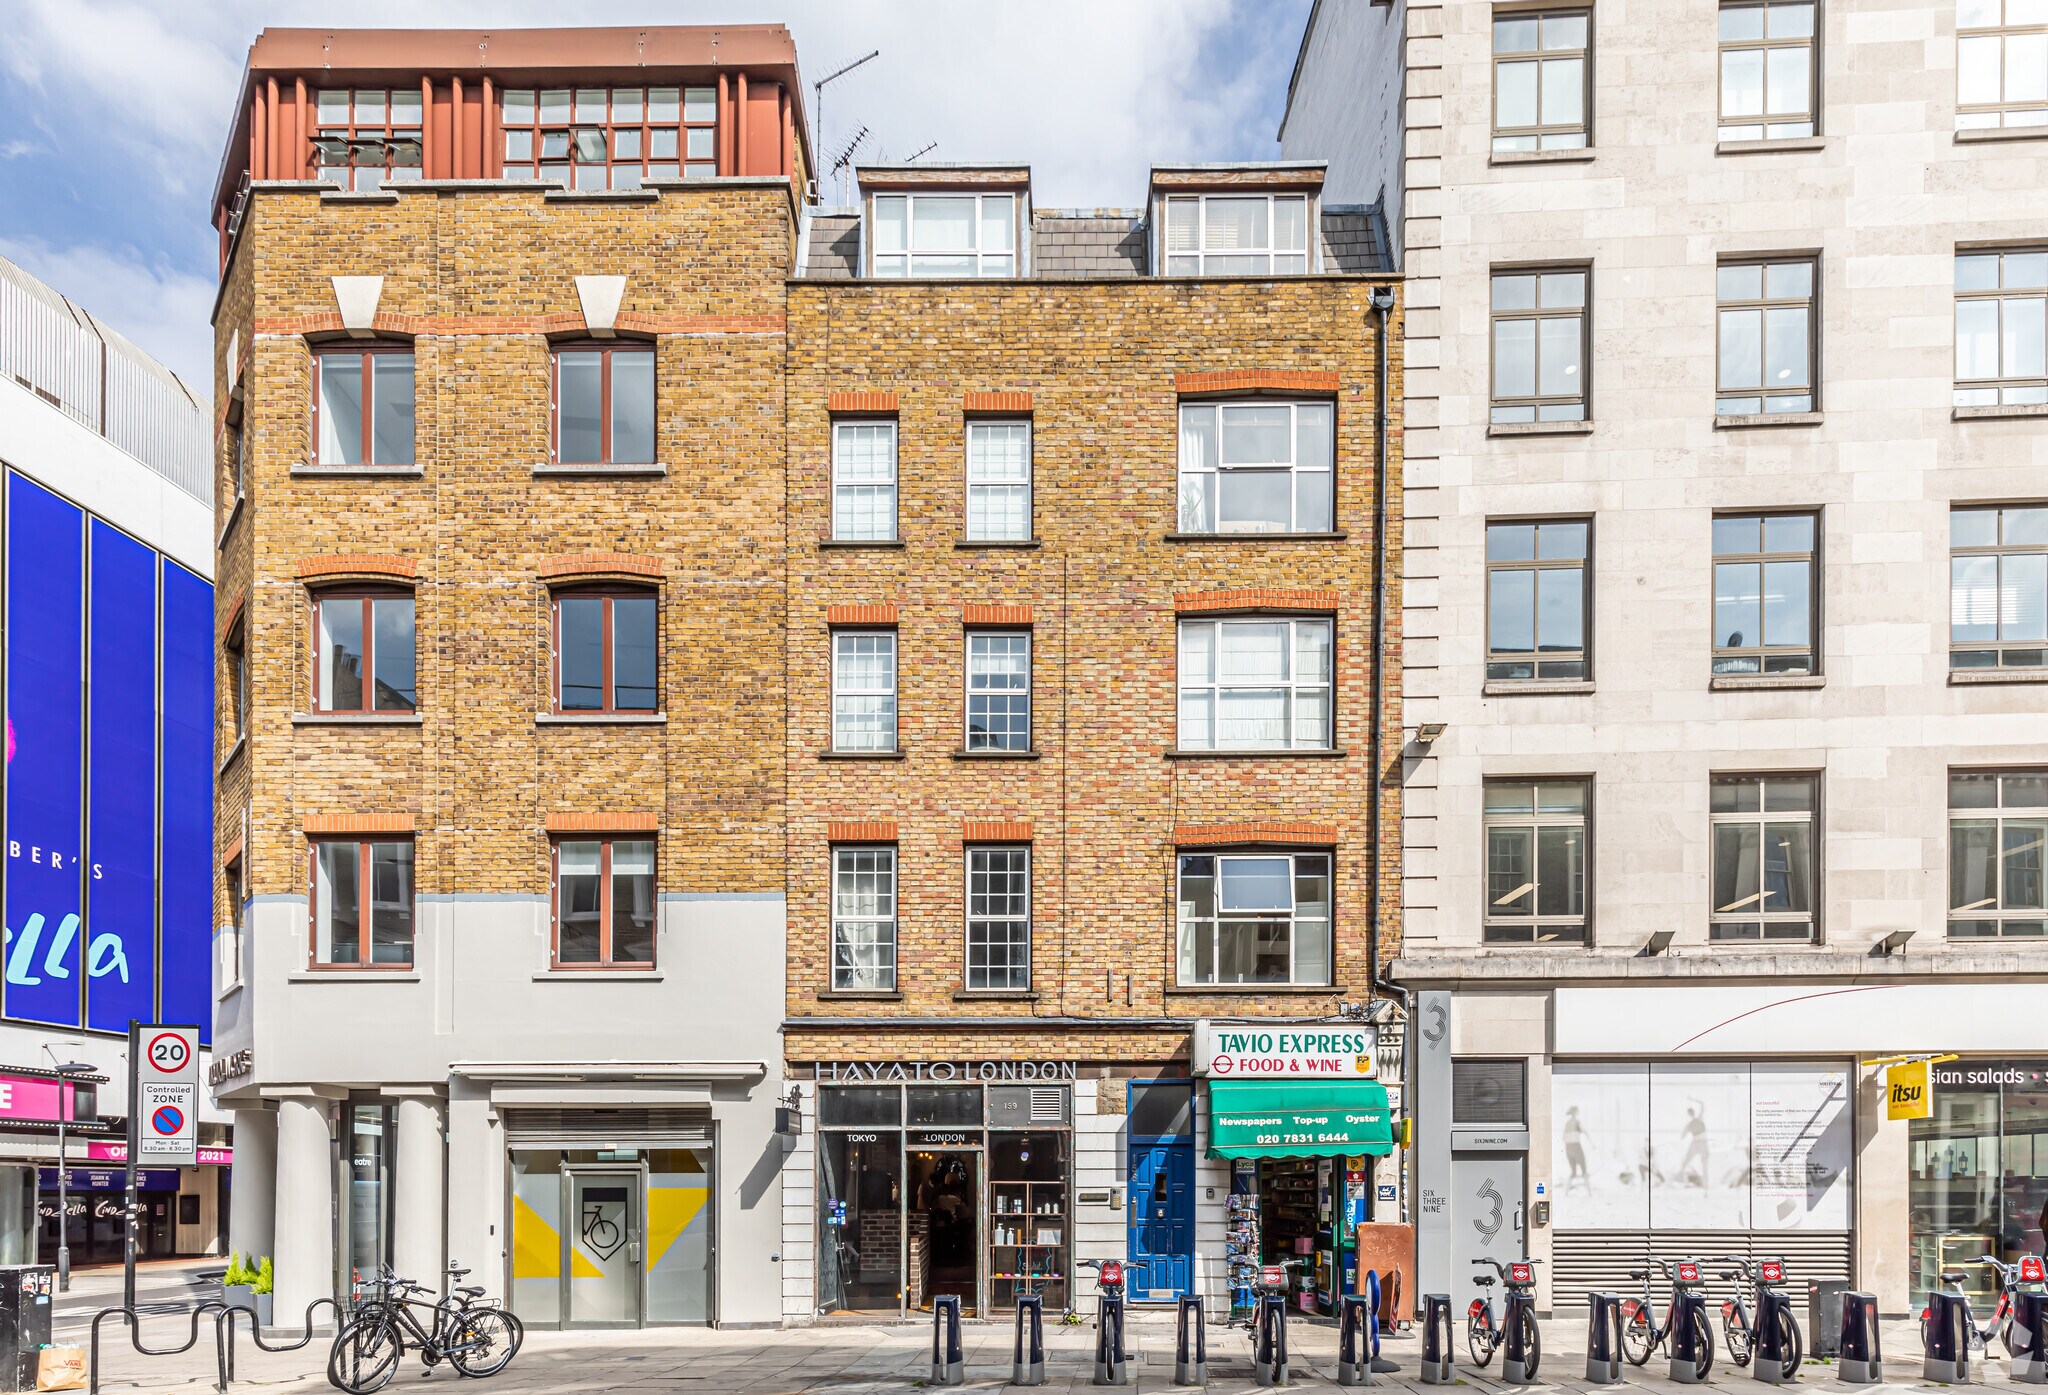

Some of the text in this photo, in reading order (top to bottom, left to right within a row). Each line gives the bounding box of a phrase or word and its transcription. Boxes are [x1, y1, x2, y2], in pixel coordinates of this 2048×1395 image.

[1218, 1034, 1364, 1053] TAVIO EXPRESS
[155, 1044, 184, 1061] 20
[815, 1061, 1077, 1080] HAYATO LONDON
[1240, 1058, 1284, 1072] FOOD
[1289, 1058, 1300, 1072] &
[1306, 1058, 1342, 1072] WINE
[1967, 1067, 2025, 1084] salads
[153, 1095, 184, 1103] ZONE
[1892, 1084, 1921, 1102] itsu
[1004, 1102, 1018, 1110] 159
[1219, 1114, 1380, 1127] Newspapers Top-up Oyster
[847, 1134, 877, 1142] TOKYO
[926, 1133, 965, 1142] LONDON
[1257, 1133, 1349, 1144] 020 7831 6444
[200, 1150, 224, 1161] 2021
[1237, 1160, 1254, 1168] Lyca
